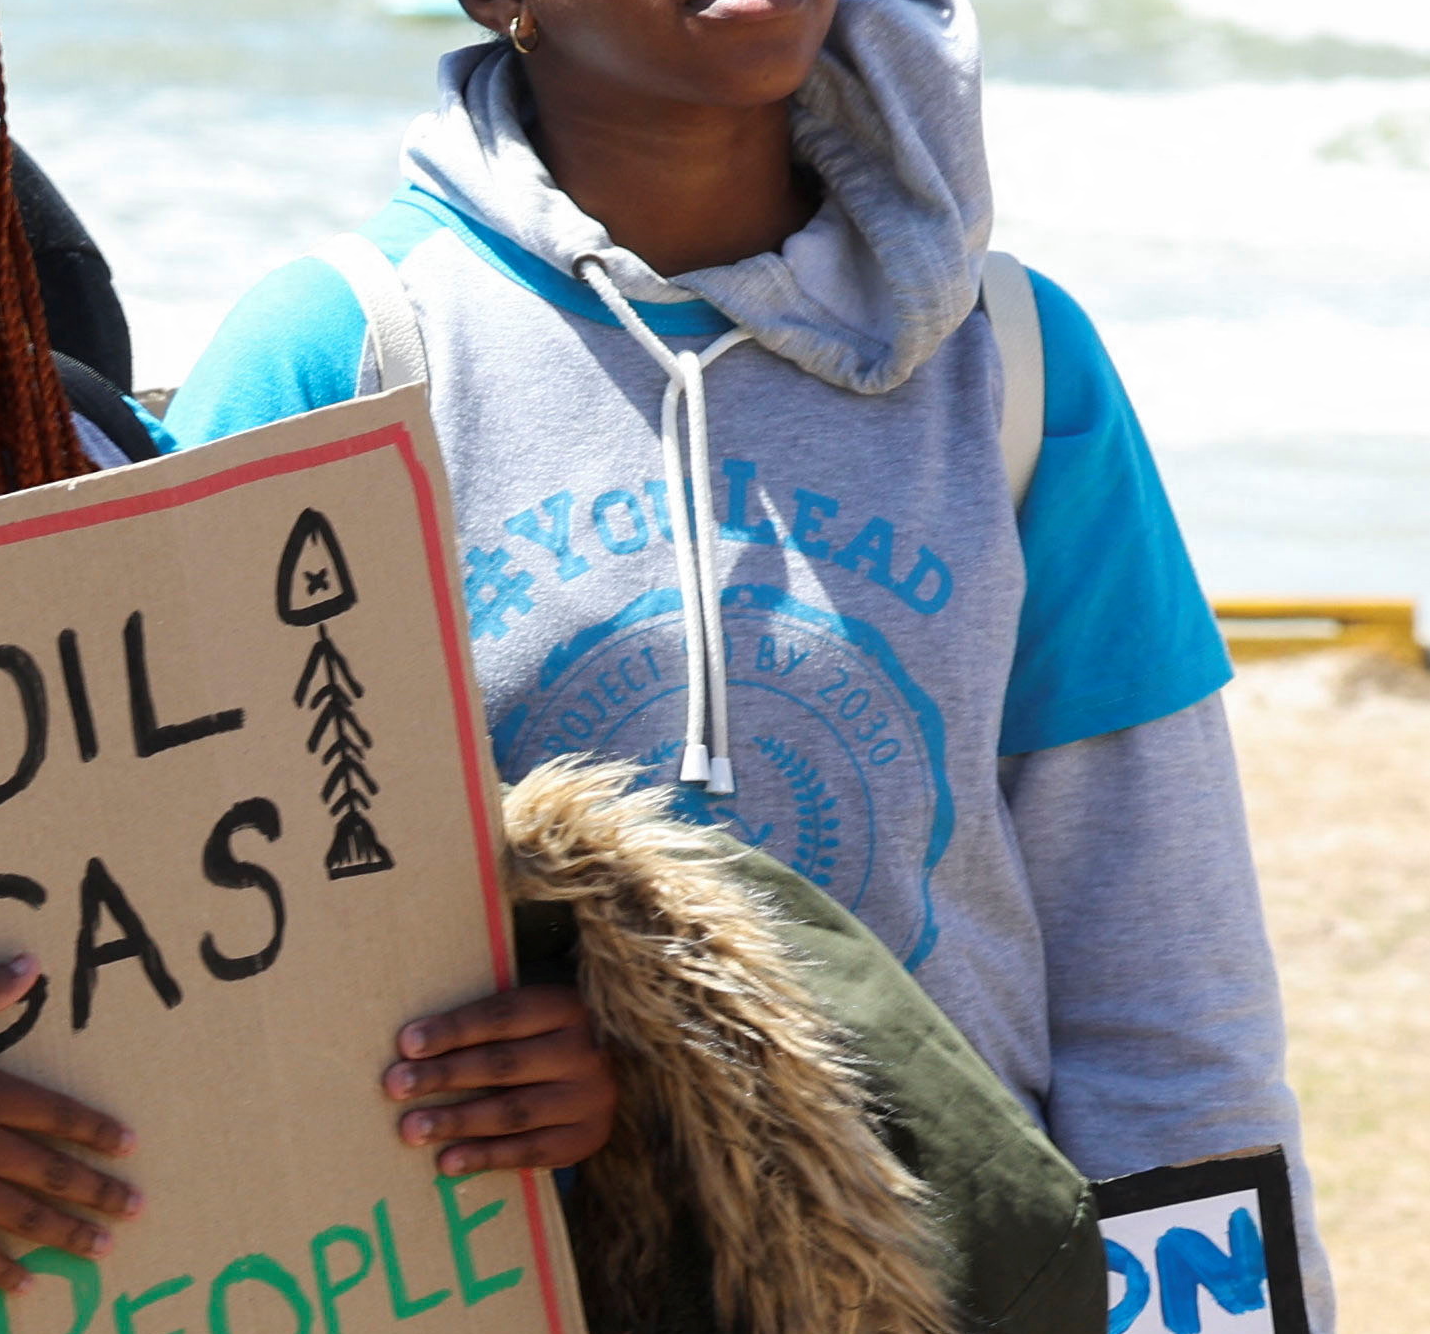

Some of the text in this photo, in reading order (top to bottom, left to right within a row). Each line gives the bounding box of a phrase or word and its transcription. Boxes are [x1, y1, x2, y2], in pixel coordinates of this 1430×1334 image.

[531, 635, 903, 768] ROJECT BY 2030
